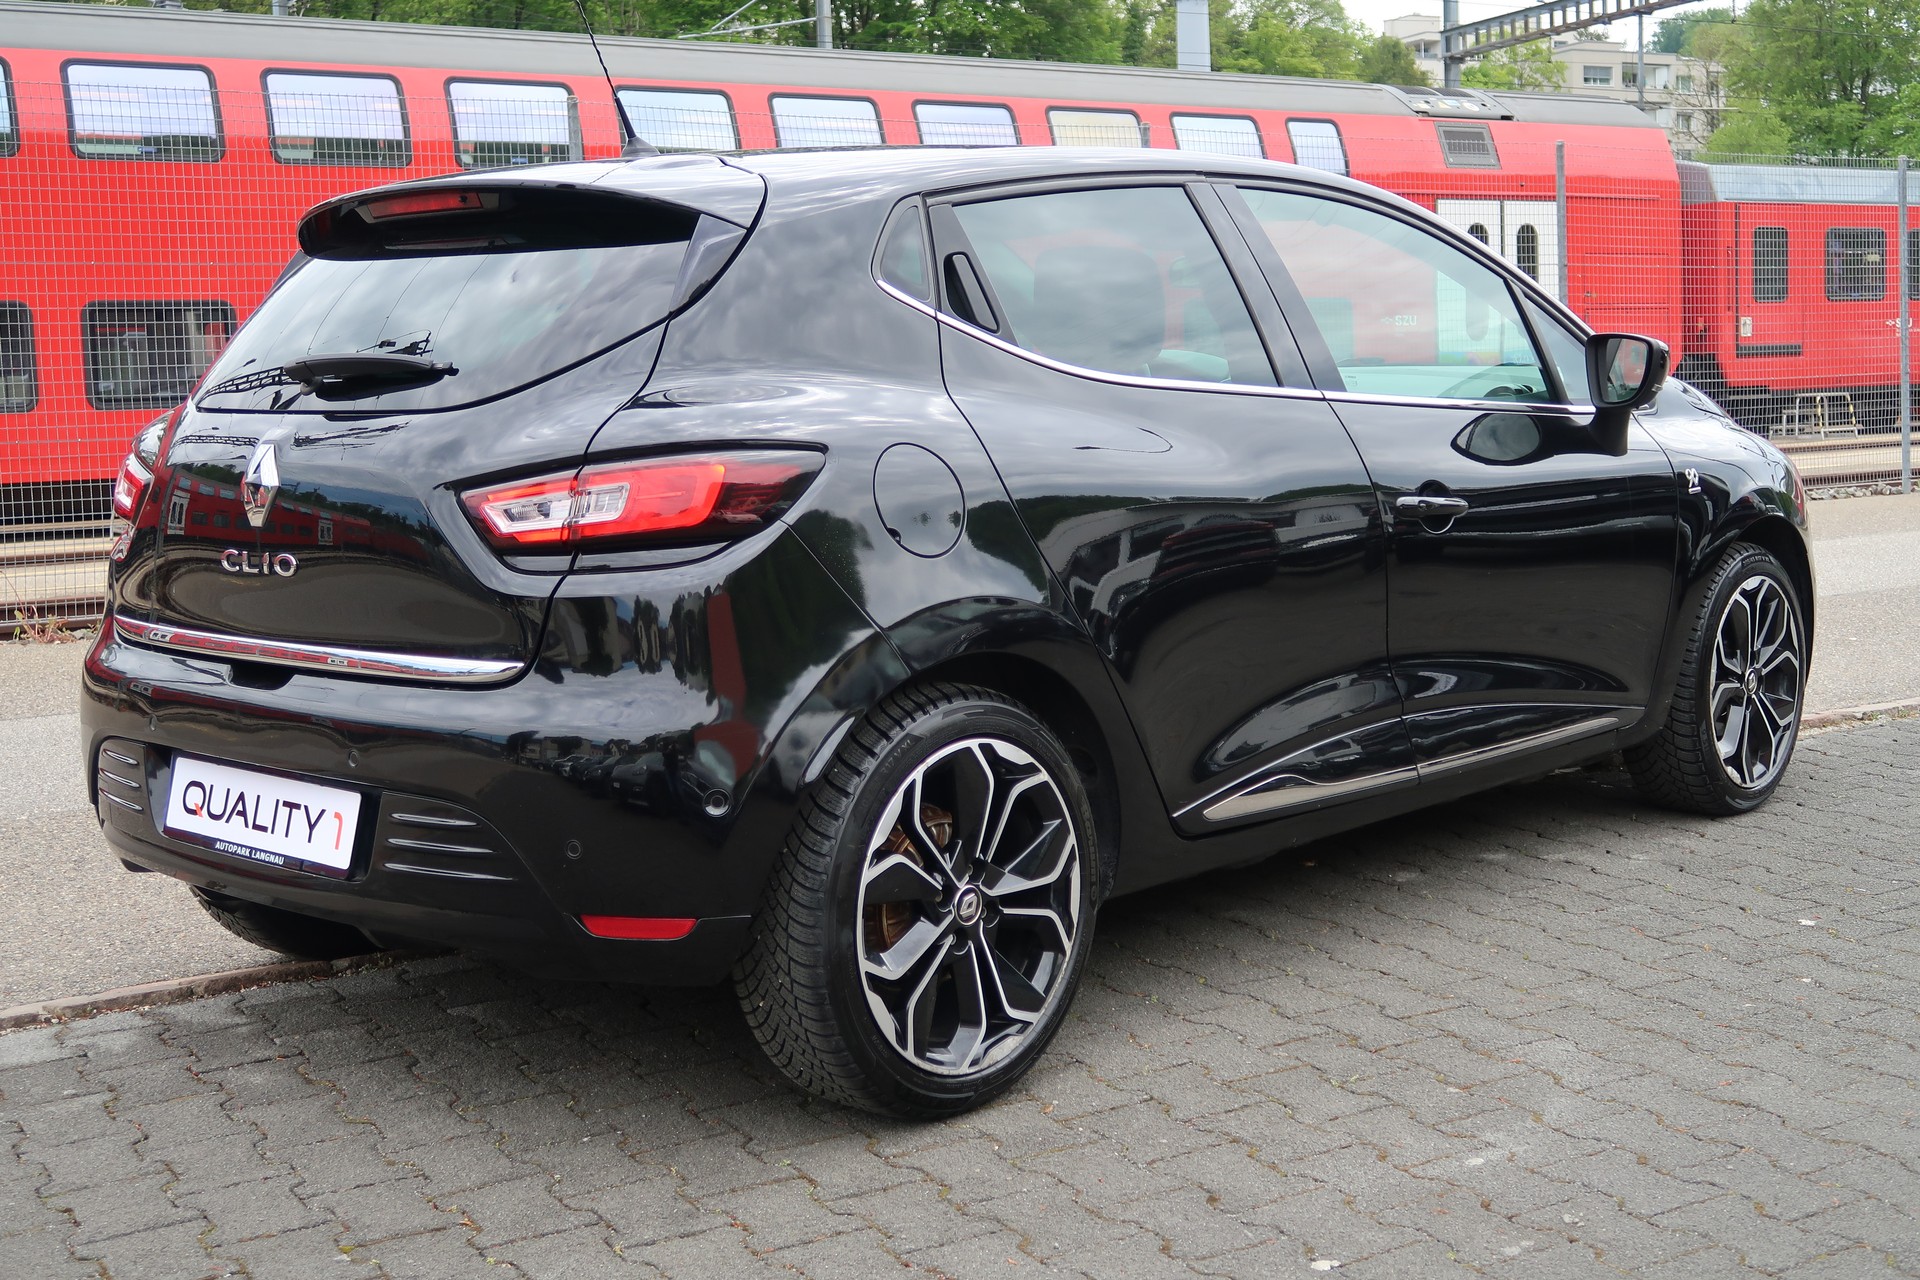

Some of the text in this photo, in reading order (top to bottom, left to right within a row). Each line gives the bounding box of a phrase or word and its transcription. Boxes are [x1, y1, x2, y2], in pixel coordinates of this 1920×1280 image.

[1395, 315, 1417, 326] SZU
[1895, 318, 1913, 328] SU
[221, 549, 298, 577] CLIO
[182, 780, 327, 844] QUALITY
[215, 840, 284, 865] AUTOPARK LANGNAU
